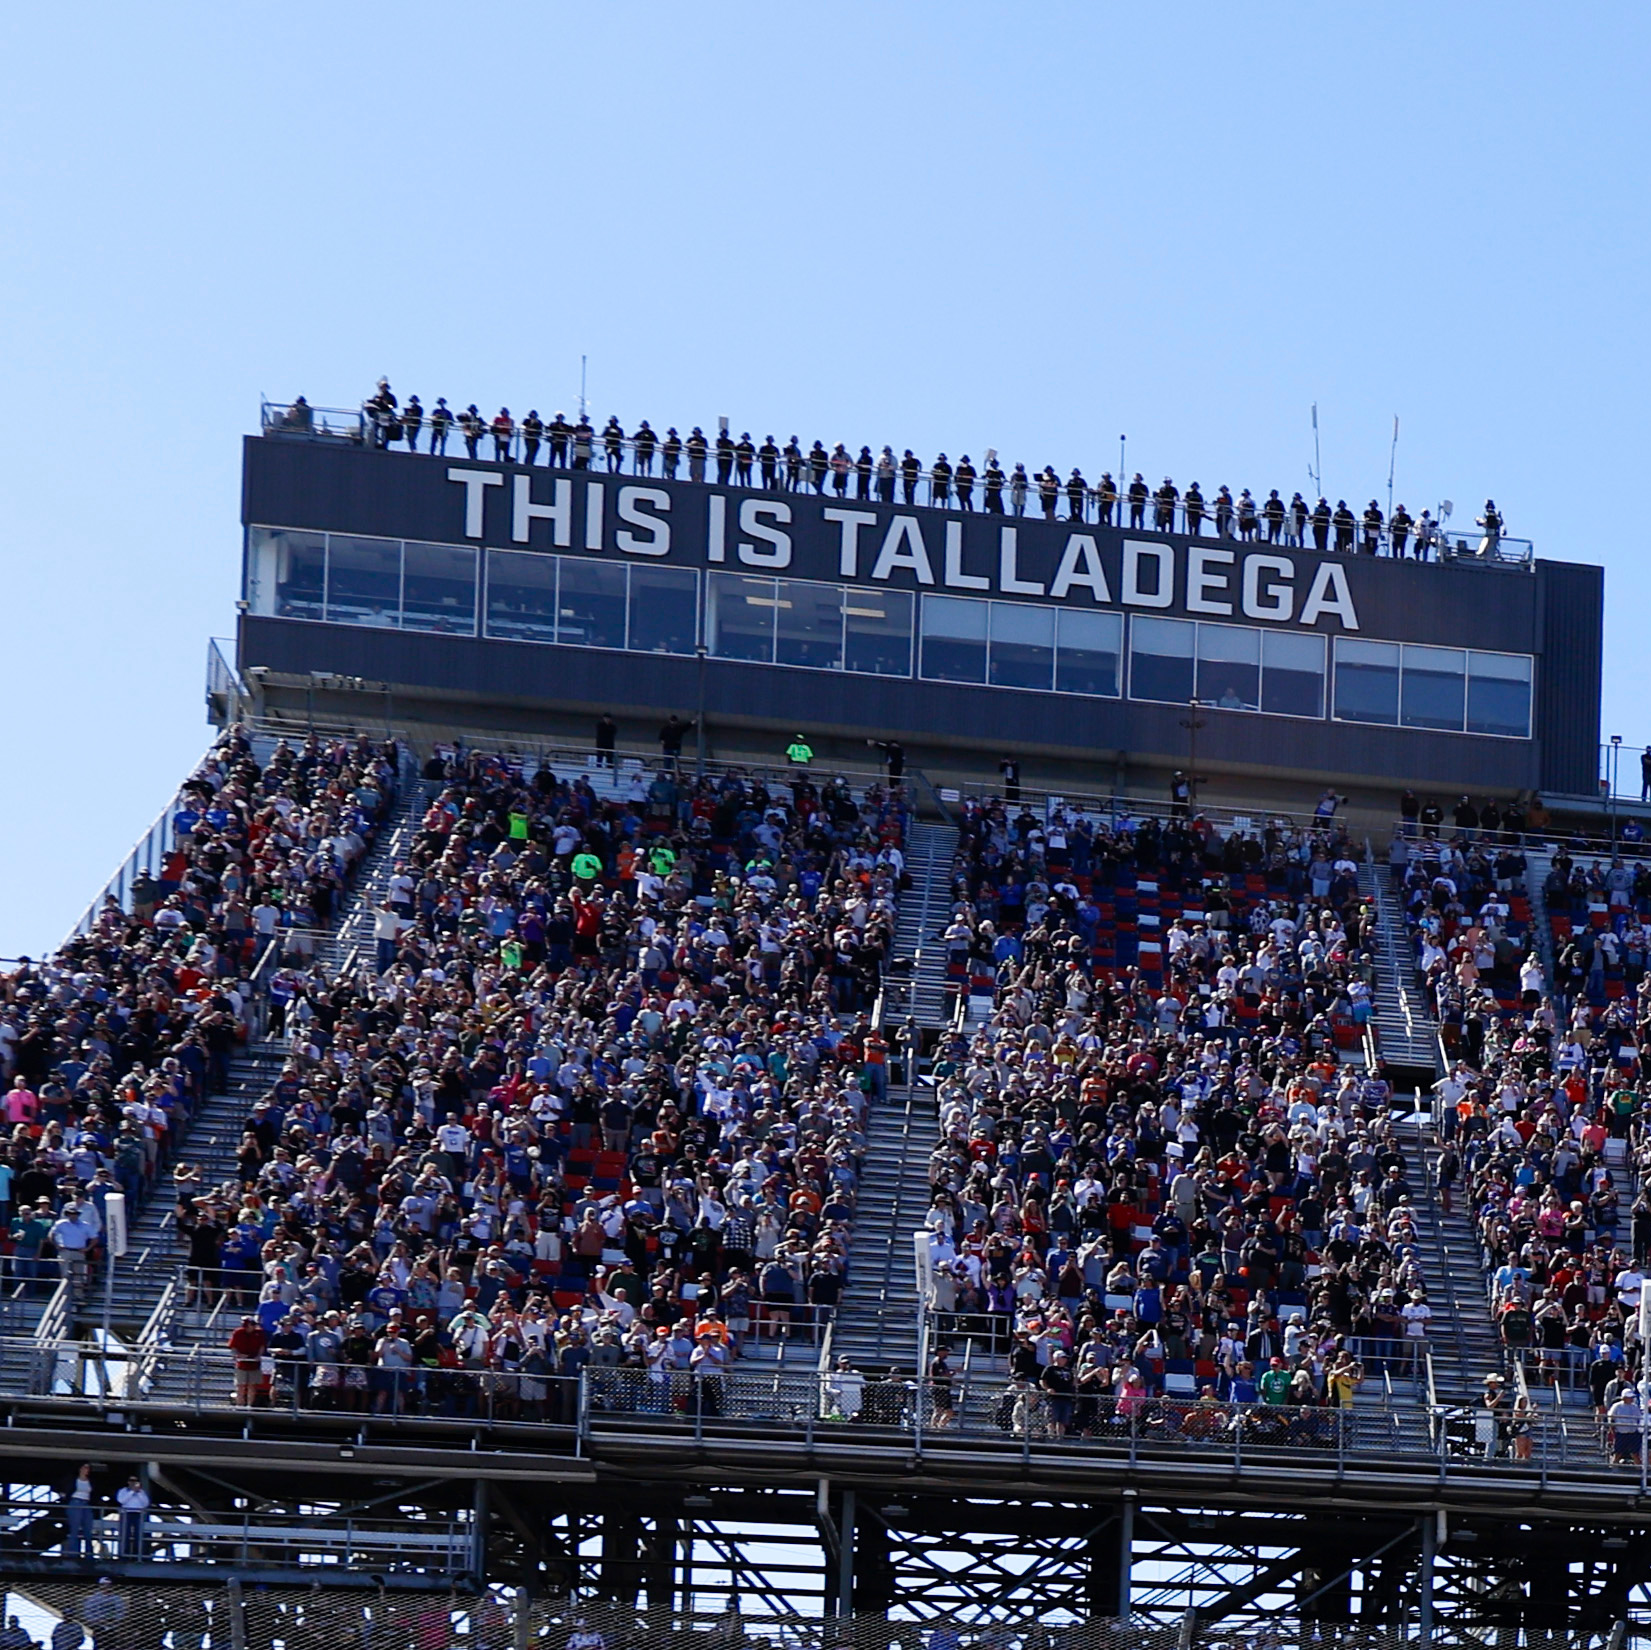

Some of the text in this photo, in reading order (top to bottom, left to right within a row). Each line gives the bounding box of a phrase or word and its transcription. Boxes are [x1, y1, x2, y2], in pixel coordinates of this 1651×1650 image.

[446, 467, 1359, 632] THIS IS TALLADEGA
